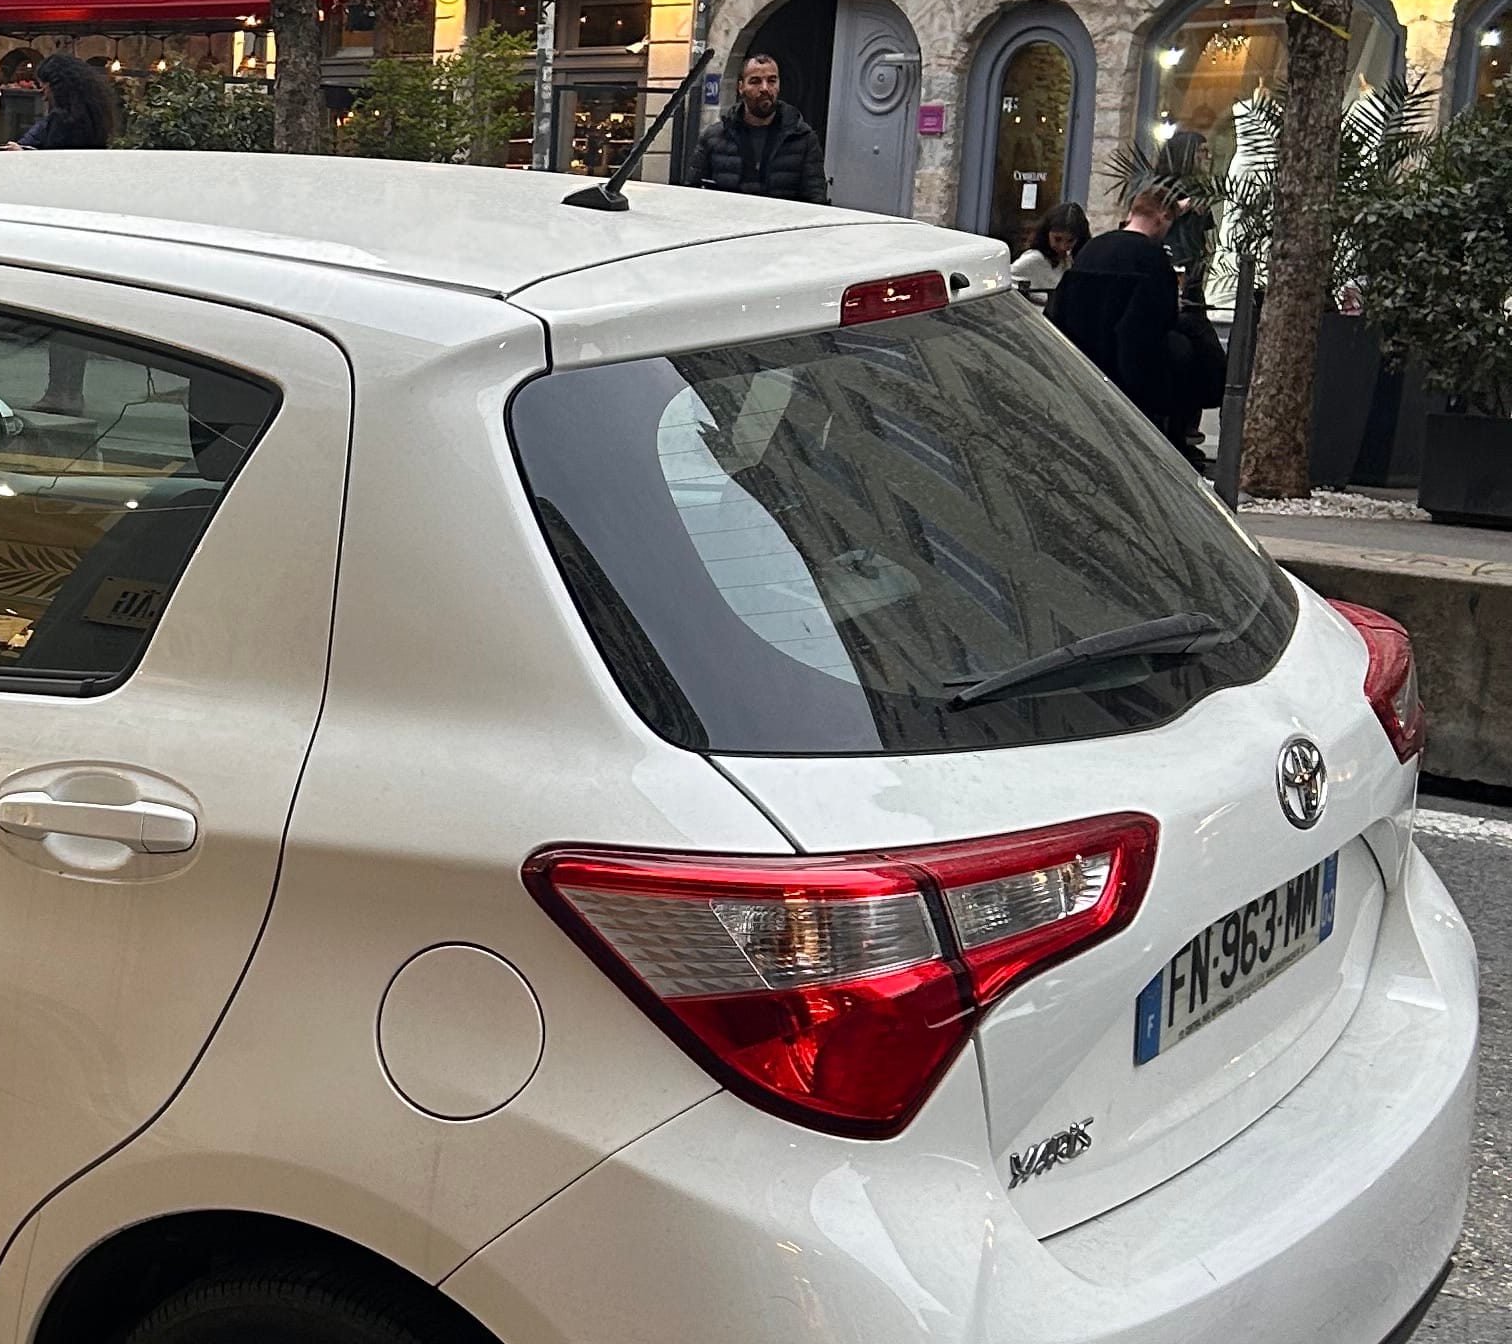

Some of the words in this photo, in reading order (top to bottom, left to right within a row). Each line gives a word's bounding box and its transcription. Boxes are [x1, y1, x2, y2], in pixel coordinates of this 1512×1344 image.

[706, 81, 719, 97] 20
[1168, 863, 1321, 1029] FN-963-MM
[1147, 1013, 1156, 1039] F
[1007, 1116, 1095, 1190] YARIS
